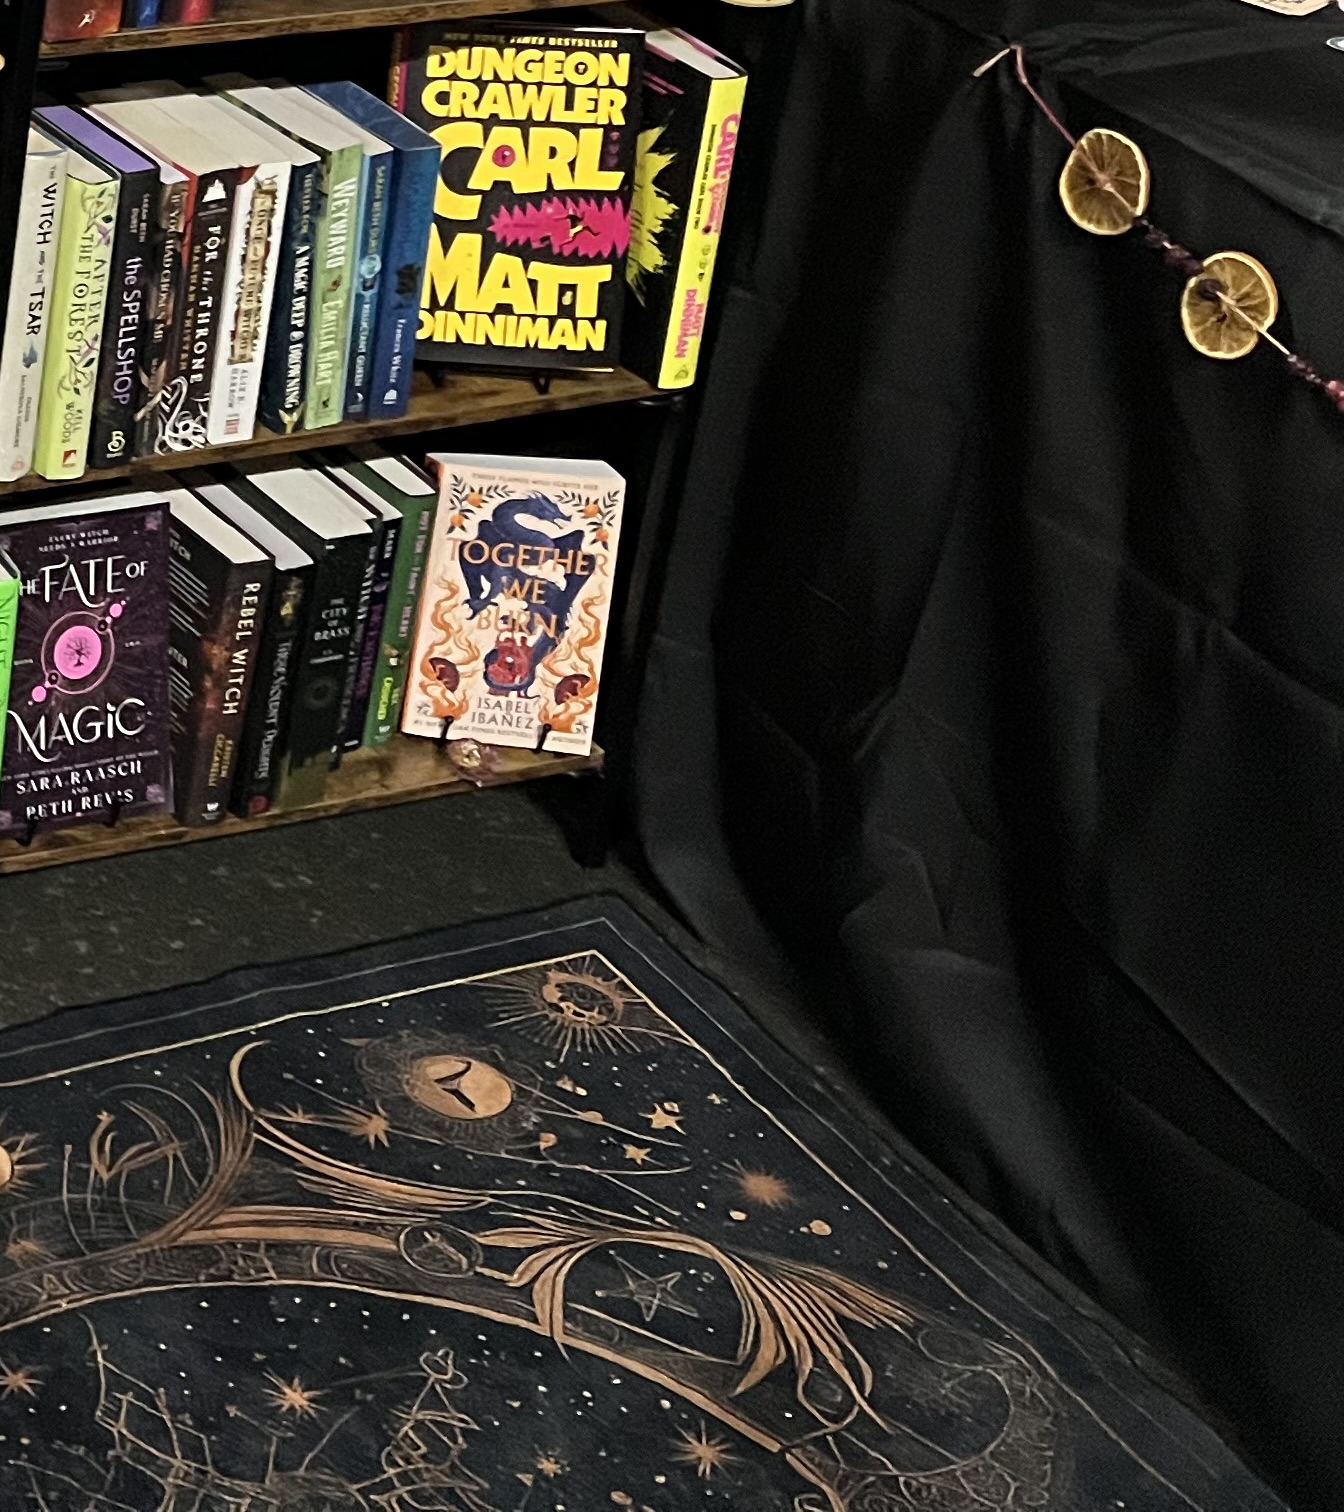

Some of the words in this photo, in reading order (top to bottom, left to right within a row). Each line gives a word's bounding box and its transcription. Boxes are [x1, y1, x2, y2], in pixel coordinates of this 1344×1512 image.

[426, 46, 631, 86] DUNGEON
[421, 80, 628, 126] CRAWLER
[428, 120, 626, 221] CARL
[36, 182, 58, 246] WITCH
[421, 222, 613, 318] MATT
[25, 286, 46, 337] TSAR
[415, 311, 607, 351] DINNIMAN
[39, 555, 128, 609] FATE
[125, 560, 148, 579] OF
[448, 537, 609, 577] TOGETHER
[234, 582, 261, 644] REBEL
[501, 575, 547, 605] WE
[476, 610, 558, 639] BURN
[222, 649, 251, 716] WITCH
[476, 695, 532, 715] ISABEL
[7, 697, 147, 763] MAGIC
